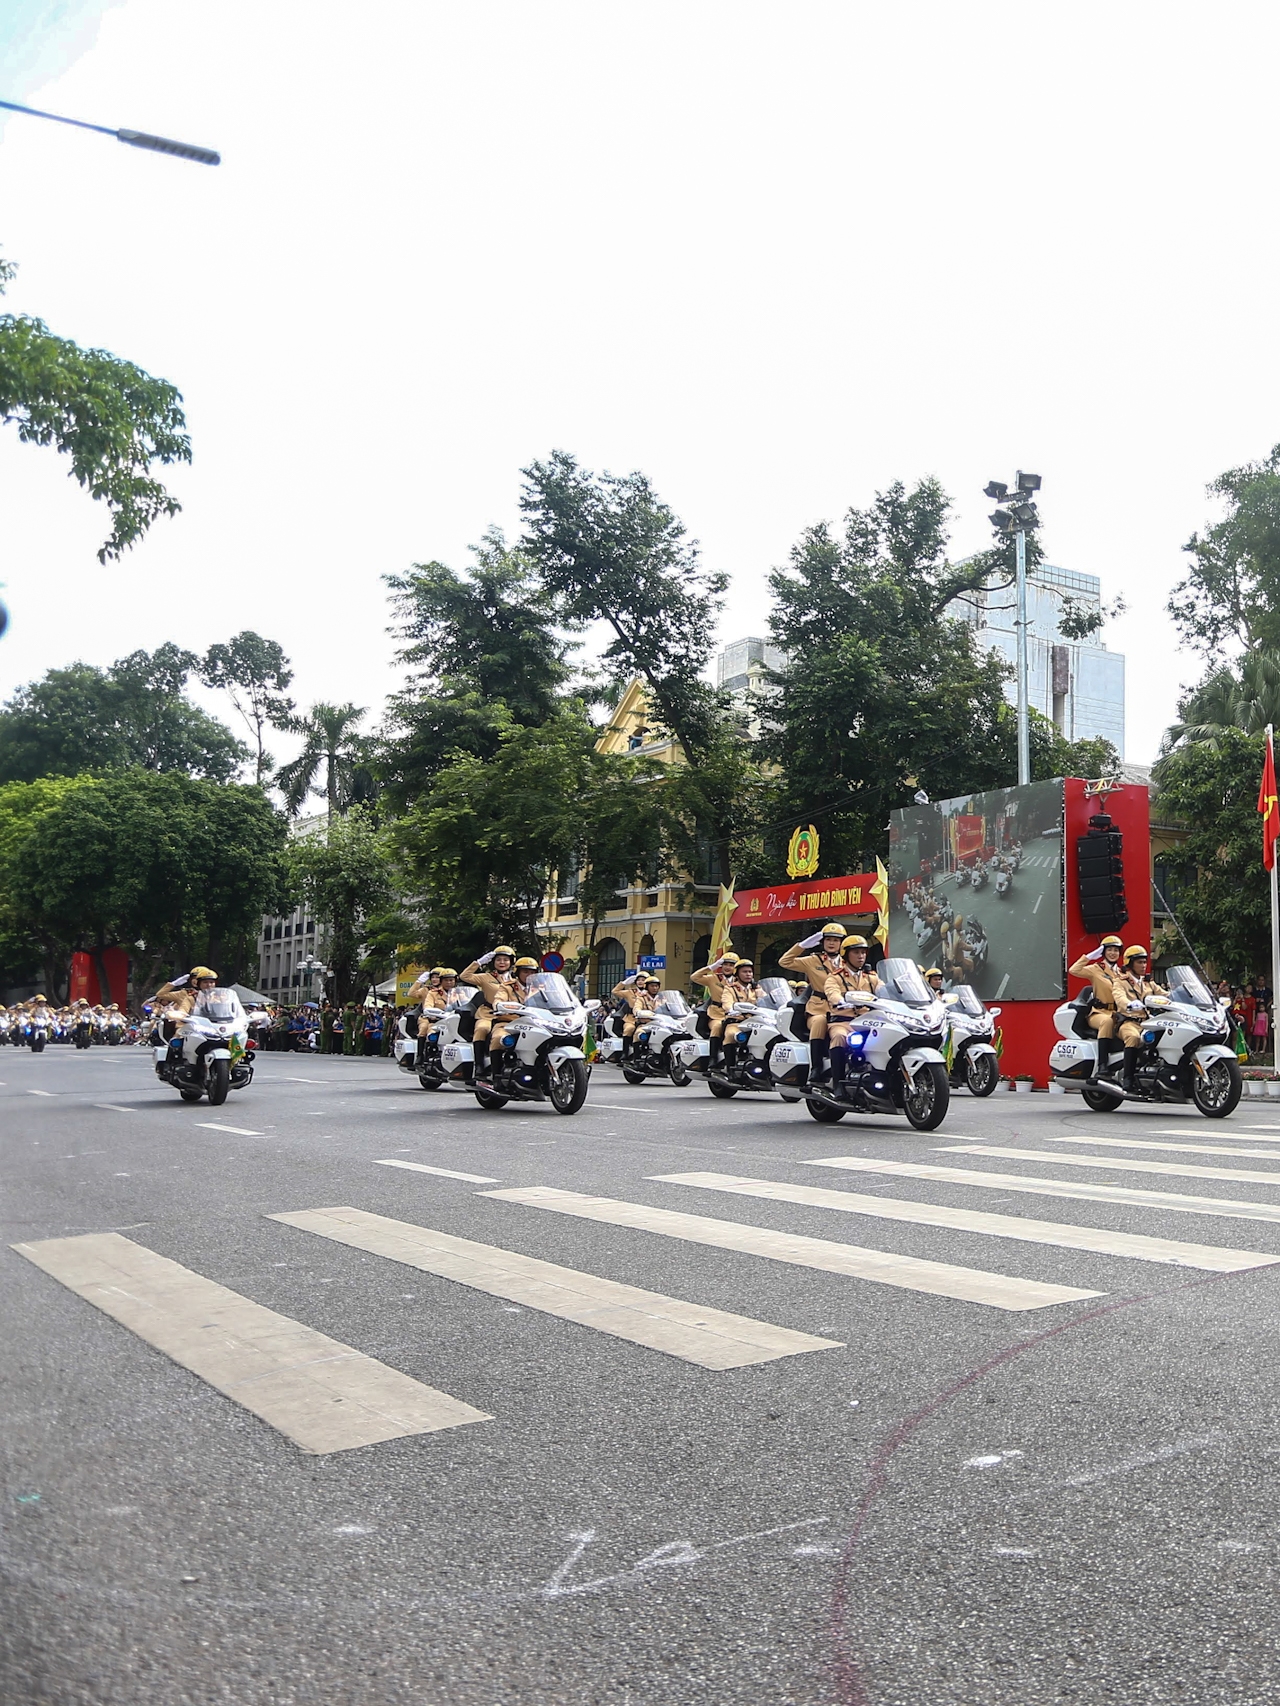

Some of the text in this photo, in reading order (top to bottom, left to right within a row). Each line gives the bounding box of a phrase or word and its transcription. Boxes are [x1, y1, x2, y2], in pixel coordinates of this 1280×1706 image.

[766, 892, 785, 917] Ngày
[831, 887, 847, 907] BÌNH
[848, 885, 862, 905] YÊN
